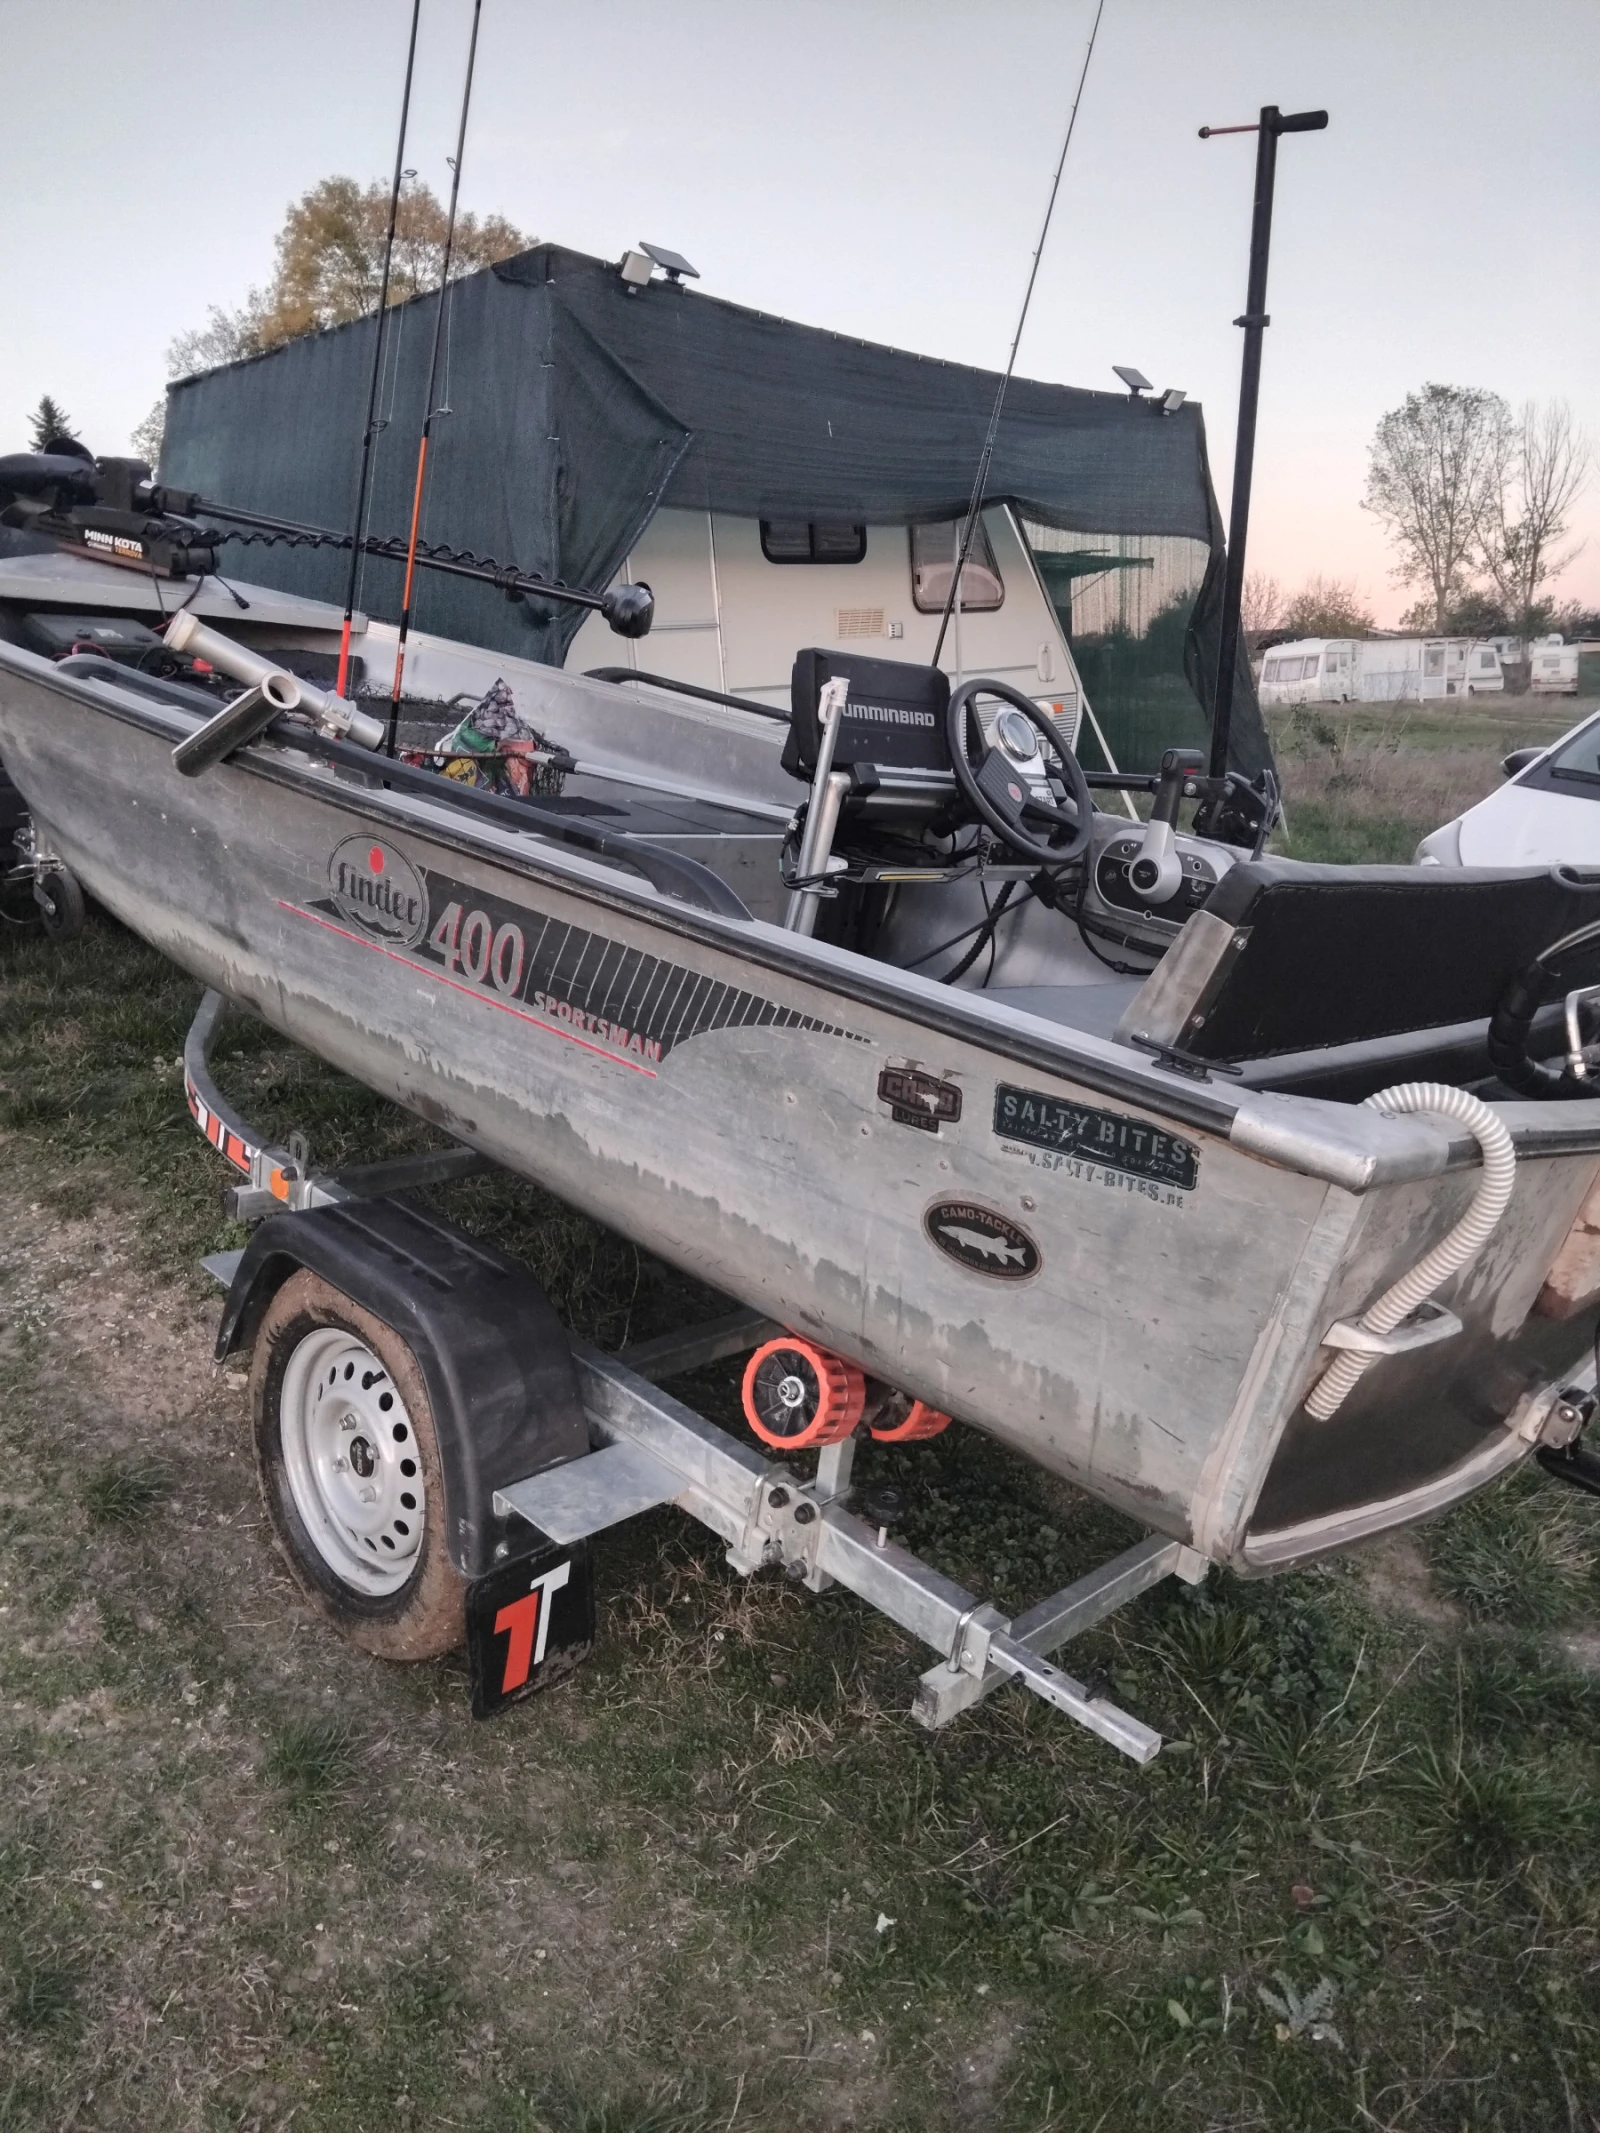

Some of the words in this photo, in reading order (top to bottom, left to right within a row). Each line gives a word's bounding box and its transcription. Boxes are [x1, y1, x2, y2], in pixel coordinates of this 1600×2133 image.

[84, 529, 113, 545] MINN
[114, 536, 143, 553] KOTA
[842, 703, 935, 727] UMMINBIRD
[429, 901, 525, 997] 400
[533, 991, 663, 1063] SPORTSMAN
[1003, 1095, 1090, 1136] SALTY
[1099, 1120, 1188, 1164] BITES
[941, 1206, 1026, 1247] CAMO-TACKLE
